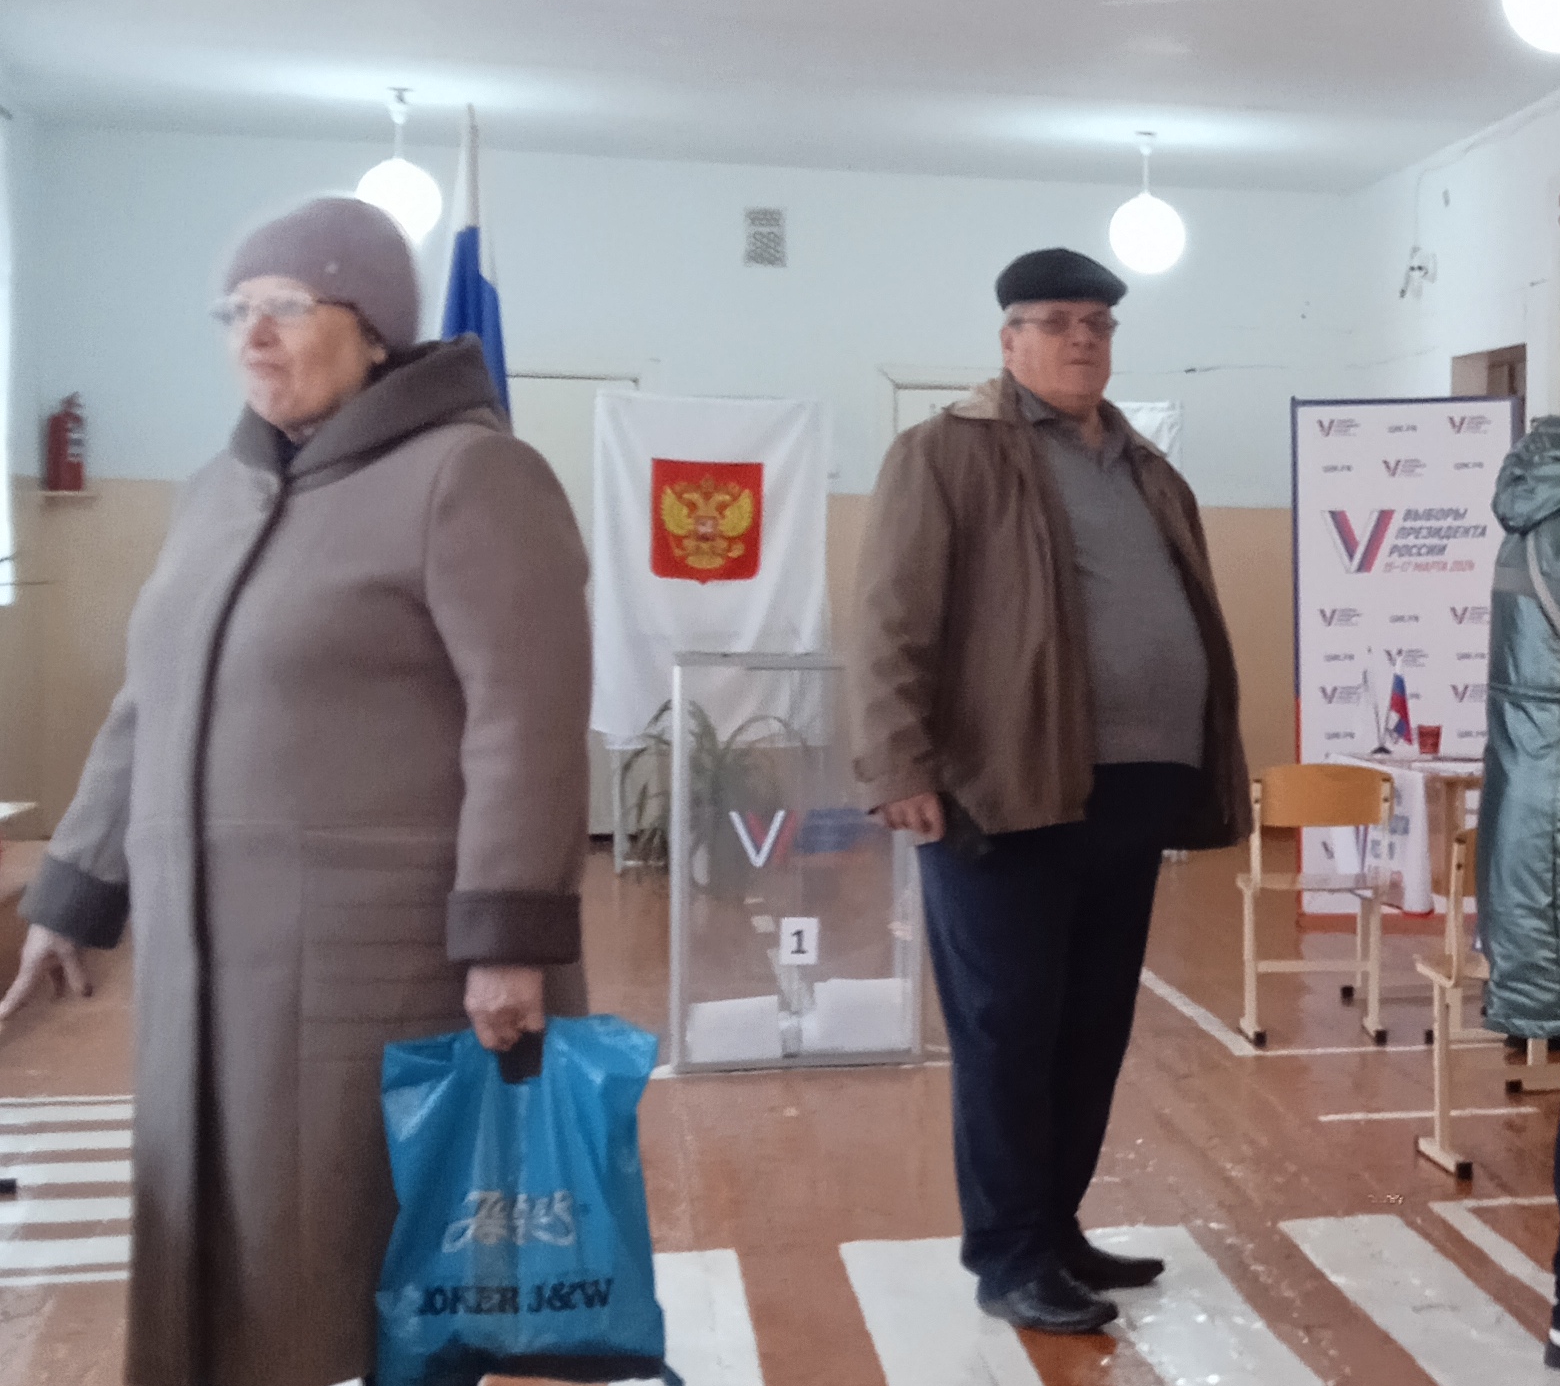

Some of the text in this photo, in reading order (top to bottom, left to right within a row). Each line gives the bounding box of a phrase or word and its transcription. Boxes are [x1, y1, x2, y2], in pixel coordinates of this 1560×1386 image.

[1395, 524, 1488, 541] ПРЕЗИДЕНТА
[1388, 543, 1448, 558] РОССИИ
[790, 929, 809, 955] 1
